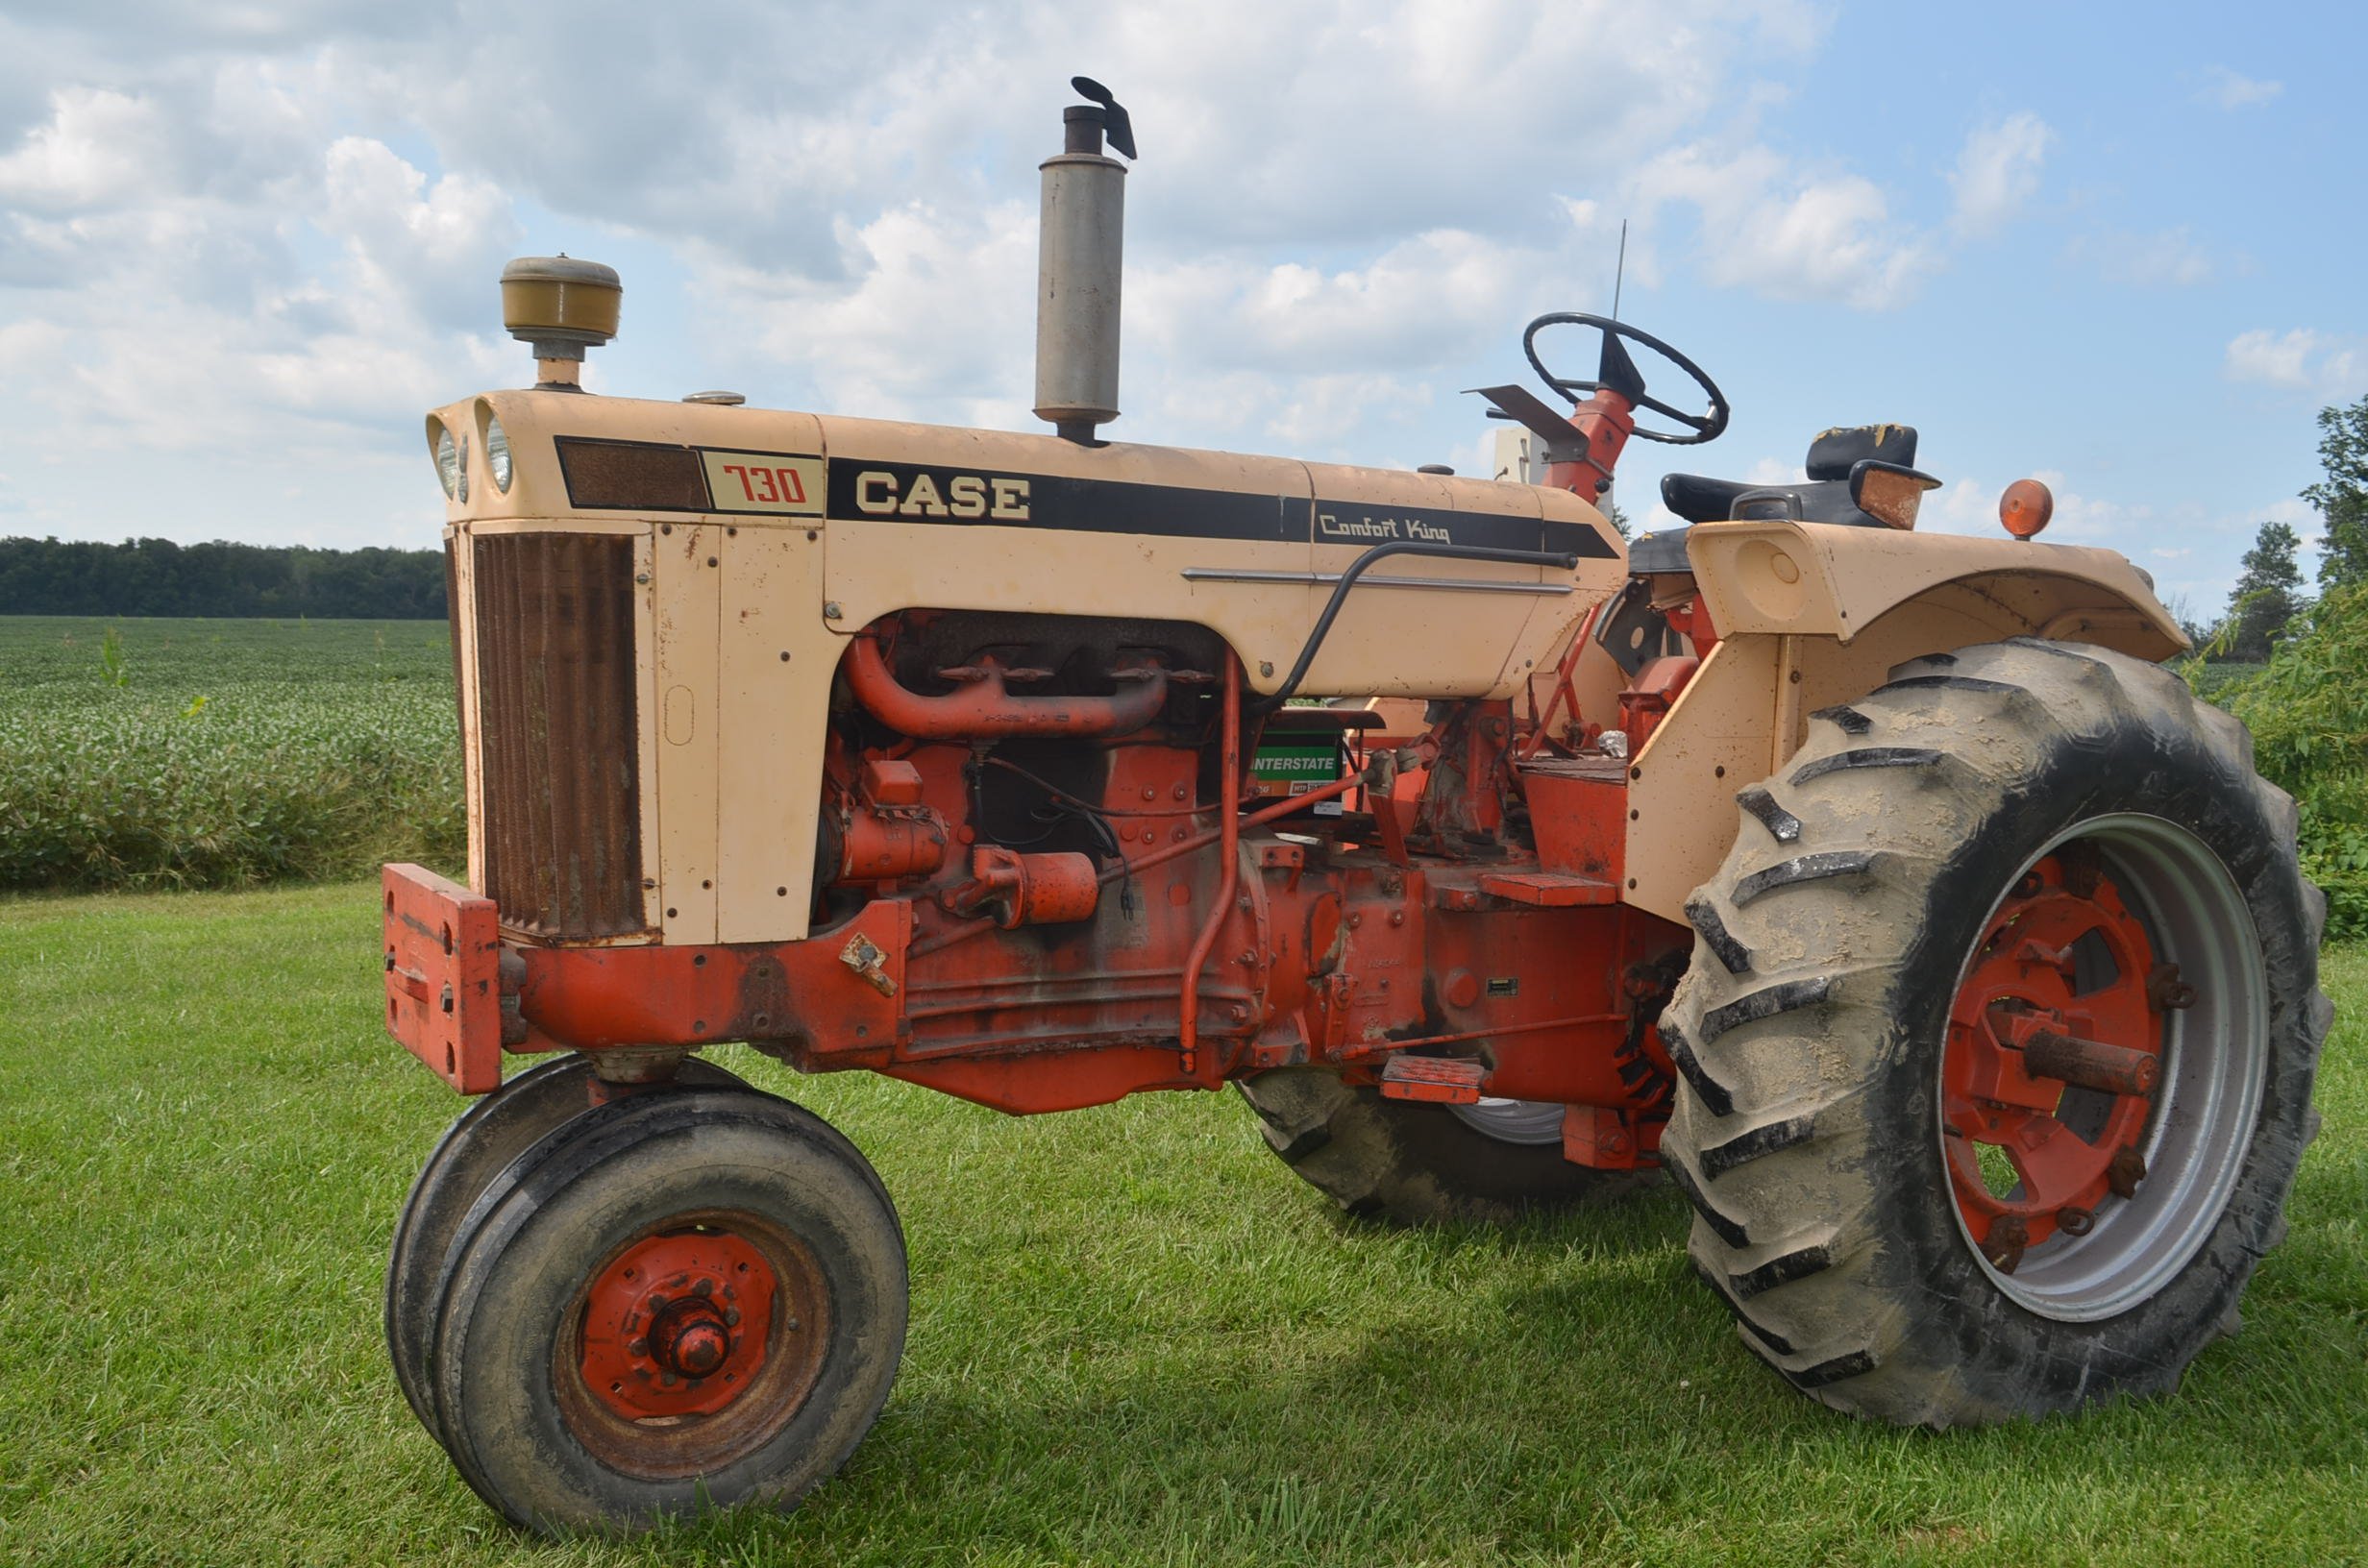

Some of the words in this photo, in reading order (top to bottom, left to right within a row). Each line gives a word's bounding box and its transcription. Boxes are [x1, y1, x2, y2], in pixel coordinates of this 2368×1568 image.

[723, 465, 806, 503] 730
[856, 471, 1030, 521] CASE
[1320, 514, 1399, 538] Comfort
[1405, 519, 1451, 545] King
